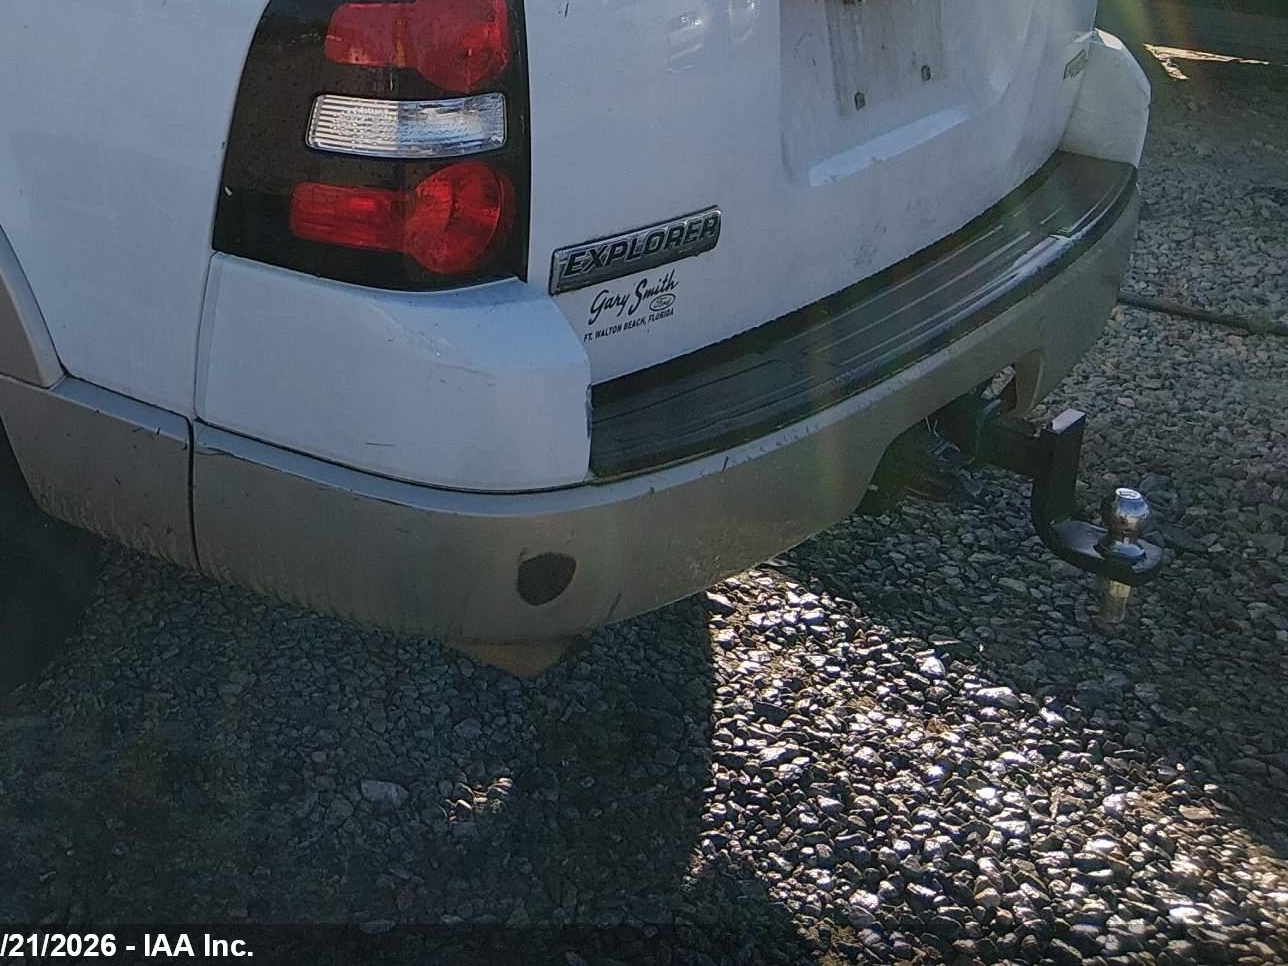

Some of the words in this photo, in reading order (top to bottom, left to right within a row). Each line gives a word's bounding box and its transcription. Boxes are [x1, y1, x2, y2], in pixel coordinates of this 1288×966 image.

[563, 214, 721, 277] EXPLORER
[587, 288, 631, 325] Gary
[628, 268, 679, 316] Smith
[594, 322, 623, 339] WALTON
[647, 307, 675, 323] FLORIDA
